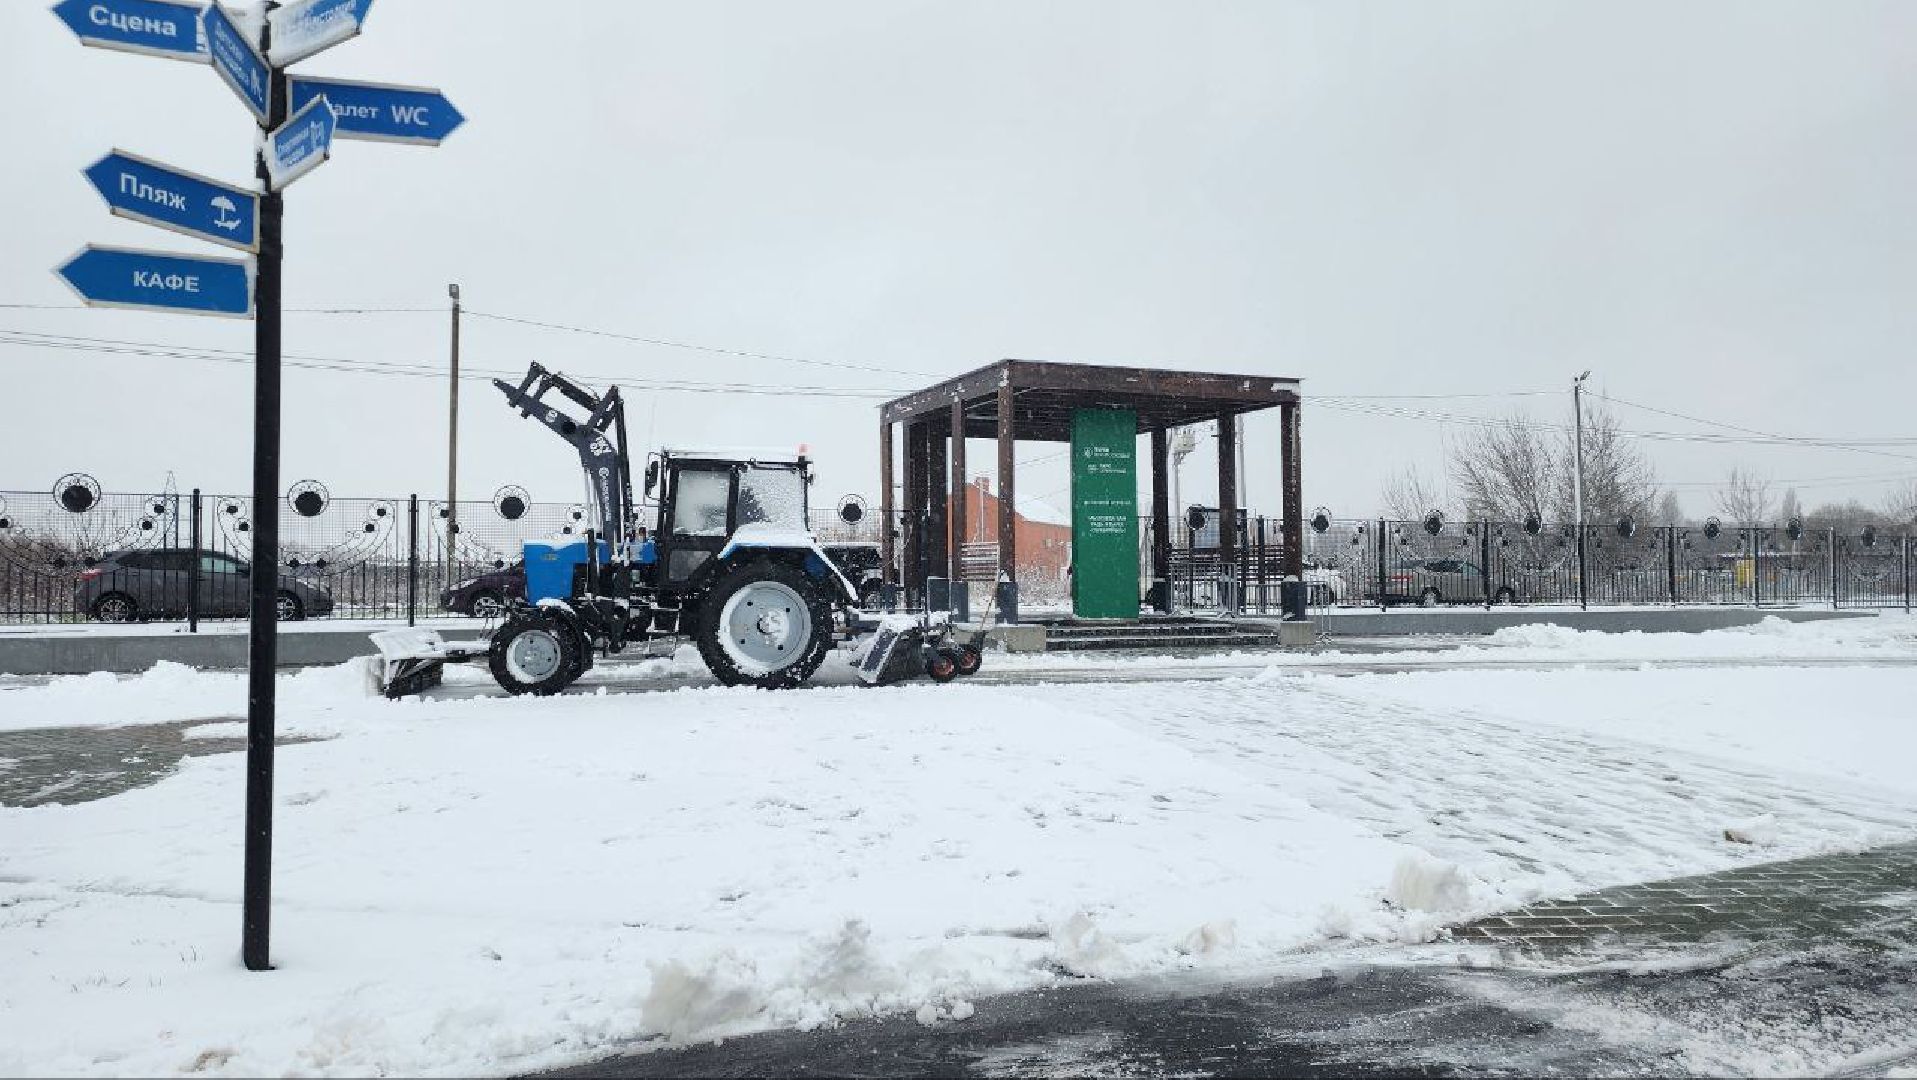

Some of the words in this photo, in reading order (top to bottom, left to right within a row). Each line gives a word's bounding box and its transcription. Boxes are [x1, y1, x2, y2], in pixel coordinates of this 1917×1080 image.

[89, 4, 177, 37] Сцена
[332, 104, 379, 119] алет
[391, 105, 429, 126] WC
[121, 172, 186, 212] Пляж
[133, 270, 200, 293] КАФЕ
